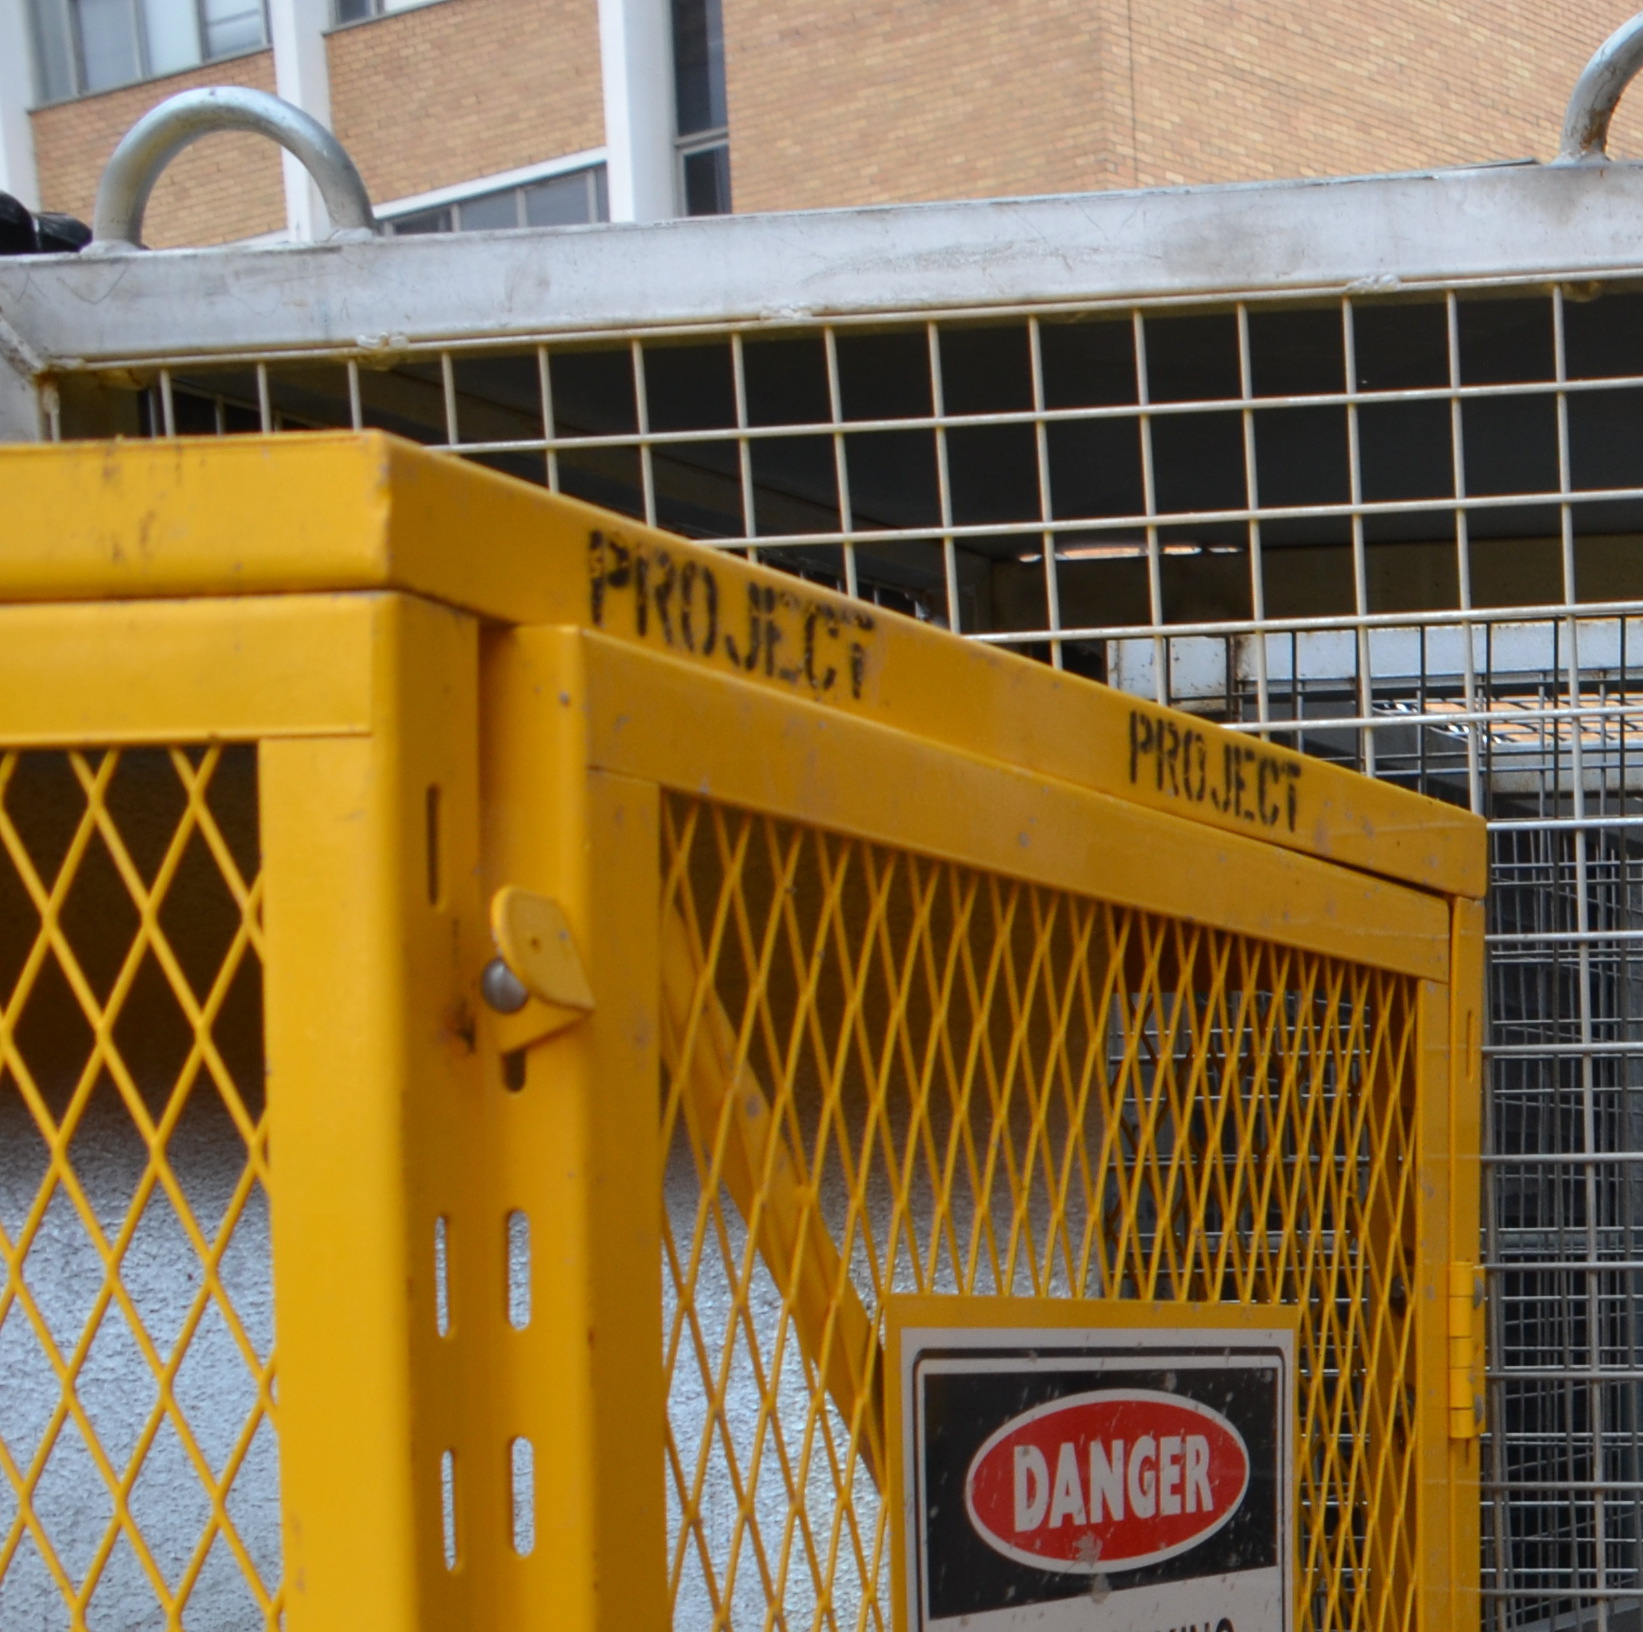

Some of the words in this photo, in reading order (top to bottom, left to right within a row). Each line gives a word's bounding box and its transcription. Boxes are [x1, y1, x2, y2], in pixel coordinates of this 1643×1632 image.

[587, 528, 875, 700] PROJECT
[1129, 710, 1302, 833] PROJECT
[1012, 1433, 1214, 1533] DANGER
